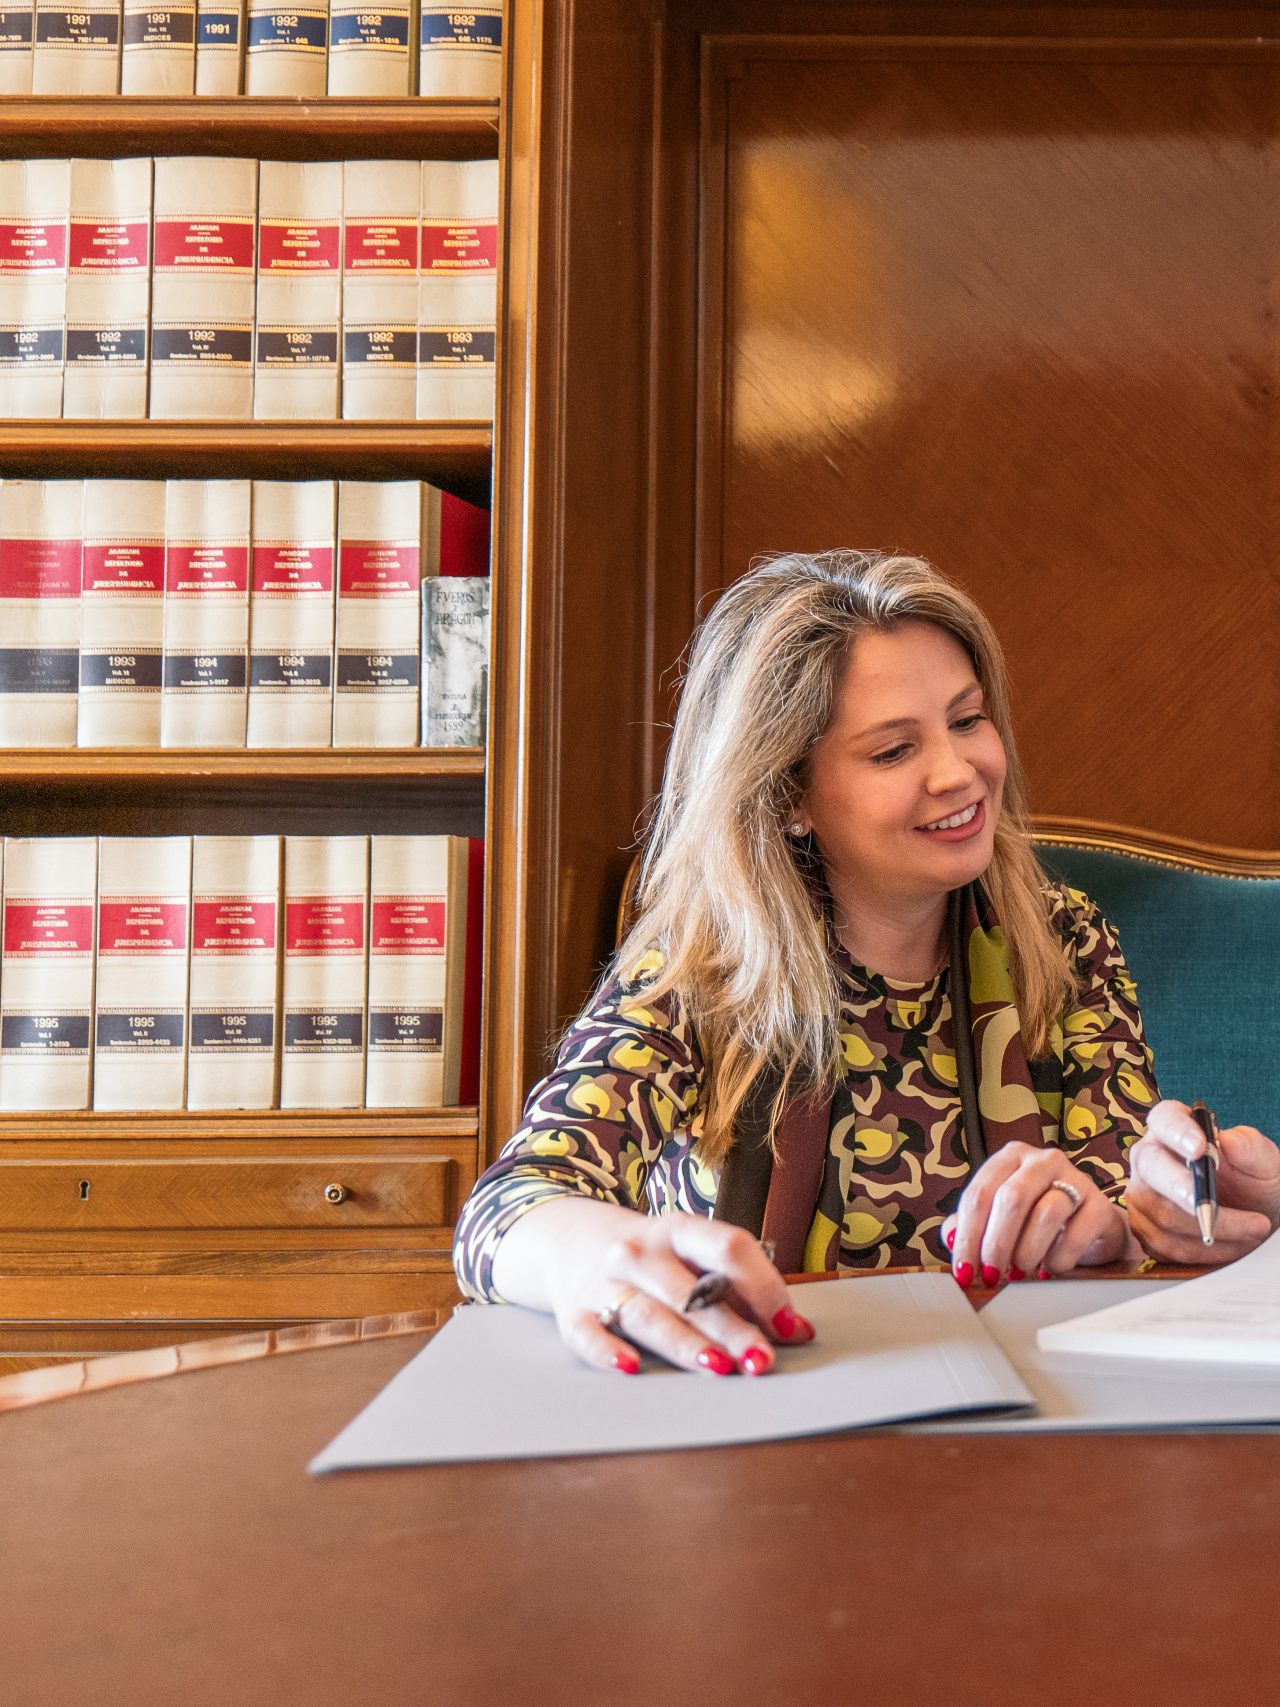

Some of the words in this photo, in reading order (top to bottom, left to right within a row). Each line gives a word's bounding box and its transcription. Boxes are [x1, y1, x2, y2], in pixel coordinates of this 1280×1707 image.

[66, 15, 90, 25] 1991
[147, 14, 170, 23] 1991
[271, 16, 298, 27] 1992
[356, 16, 381, 26] 1992
[448, 16, 475, 26] 1992
[205, 24, 230, 34] 1991
[14, 333, 38, 343] 1992
[95, 332, 121, 342] 1992
[188, 331, 215, 341] 1992
[286, 334, 312, 343] 1992
[368, 332, 393, 343] 1992
[447, 333, 472, 343] 1993
[109, 656, 135, 666] 1993
[194, 658, 217, 667] 1994
[278, 657, 305, 666] 1994
[366, 657, 392, 667] 1994
[34, 1018, 59, 1028] 1995
[128, 1017, 155, 1027] 1995
[222, 1016, 246, 1026] 1995
[311, 1016, 337, 1026] 1995
[394, 1016, 420, 1025] 1995
